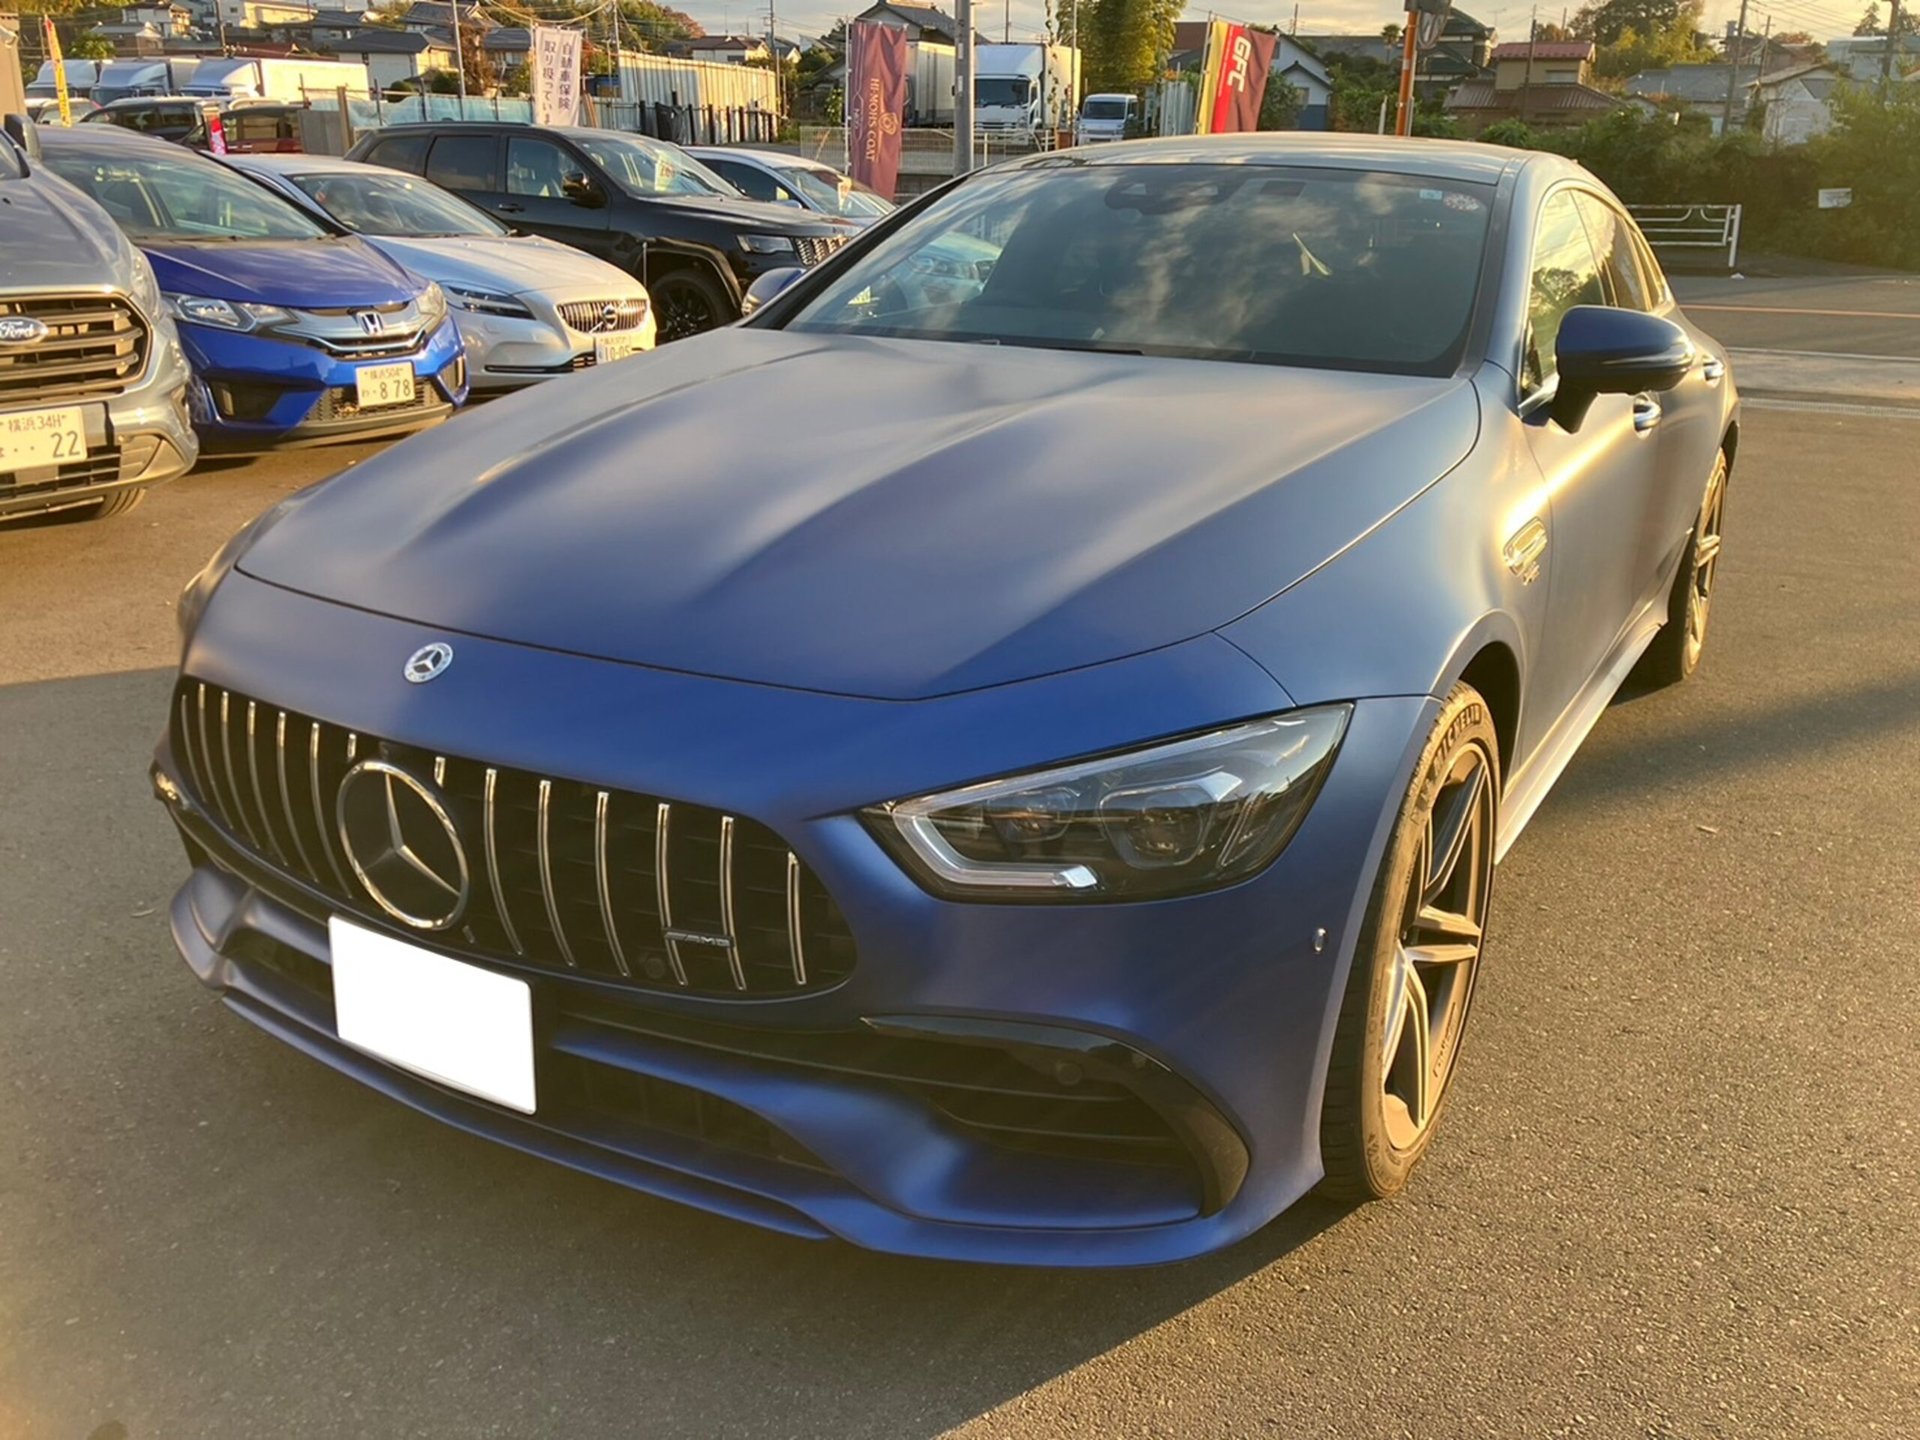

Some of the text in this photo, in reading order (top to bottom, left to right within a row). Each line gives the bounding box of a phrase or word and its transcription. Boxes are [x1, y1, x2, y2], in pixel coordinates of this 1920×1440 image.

[558, 42, 573, 111] 自動車保険
[1227, 35, 1252, 92] GFC
[865, 130, 877, 163] COAT
[0, 320, 35, 338] Ford
